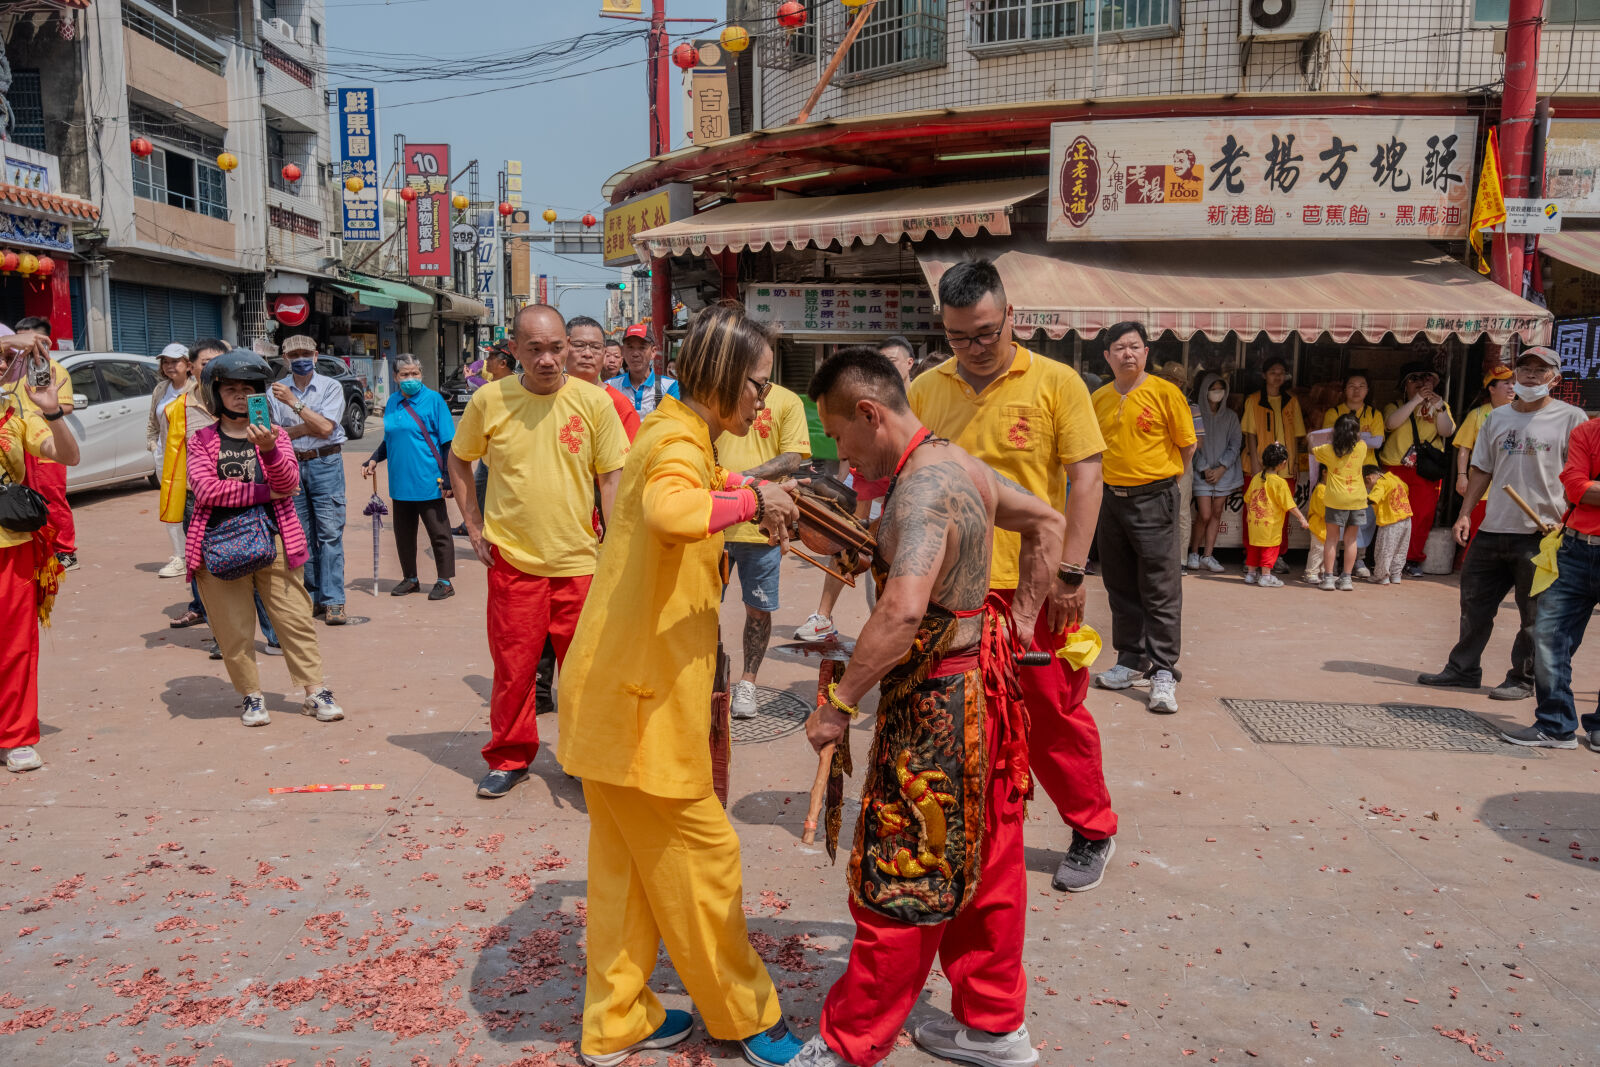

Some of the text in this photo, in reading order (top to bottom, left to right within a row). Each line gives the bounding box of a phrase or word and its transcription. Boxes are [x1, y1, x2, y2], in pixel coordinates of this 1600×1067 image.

[344, 91, 371, 157] 鮮果園
[700, 88, 723, 138] 吉利
[413, 153, 438, 174] 10
[1070, 143, 1089, 215] 正老元祖
[1125, 165, 1165, 204] 老楊
[1208, 133, 1464, 194] 老楊方塊酥
[1169, 190, 1199, 198] FOOD
[1170, 182, 1185, 190] TK
